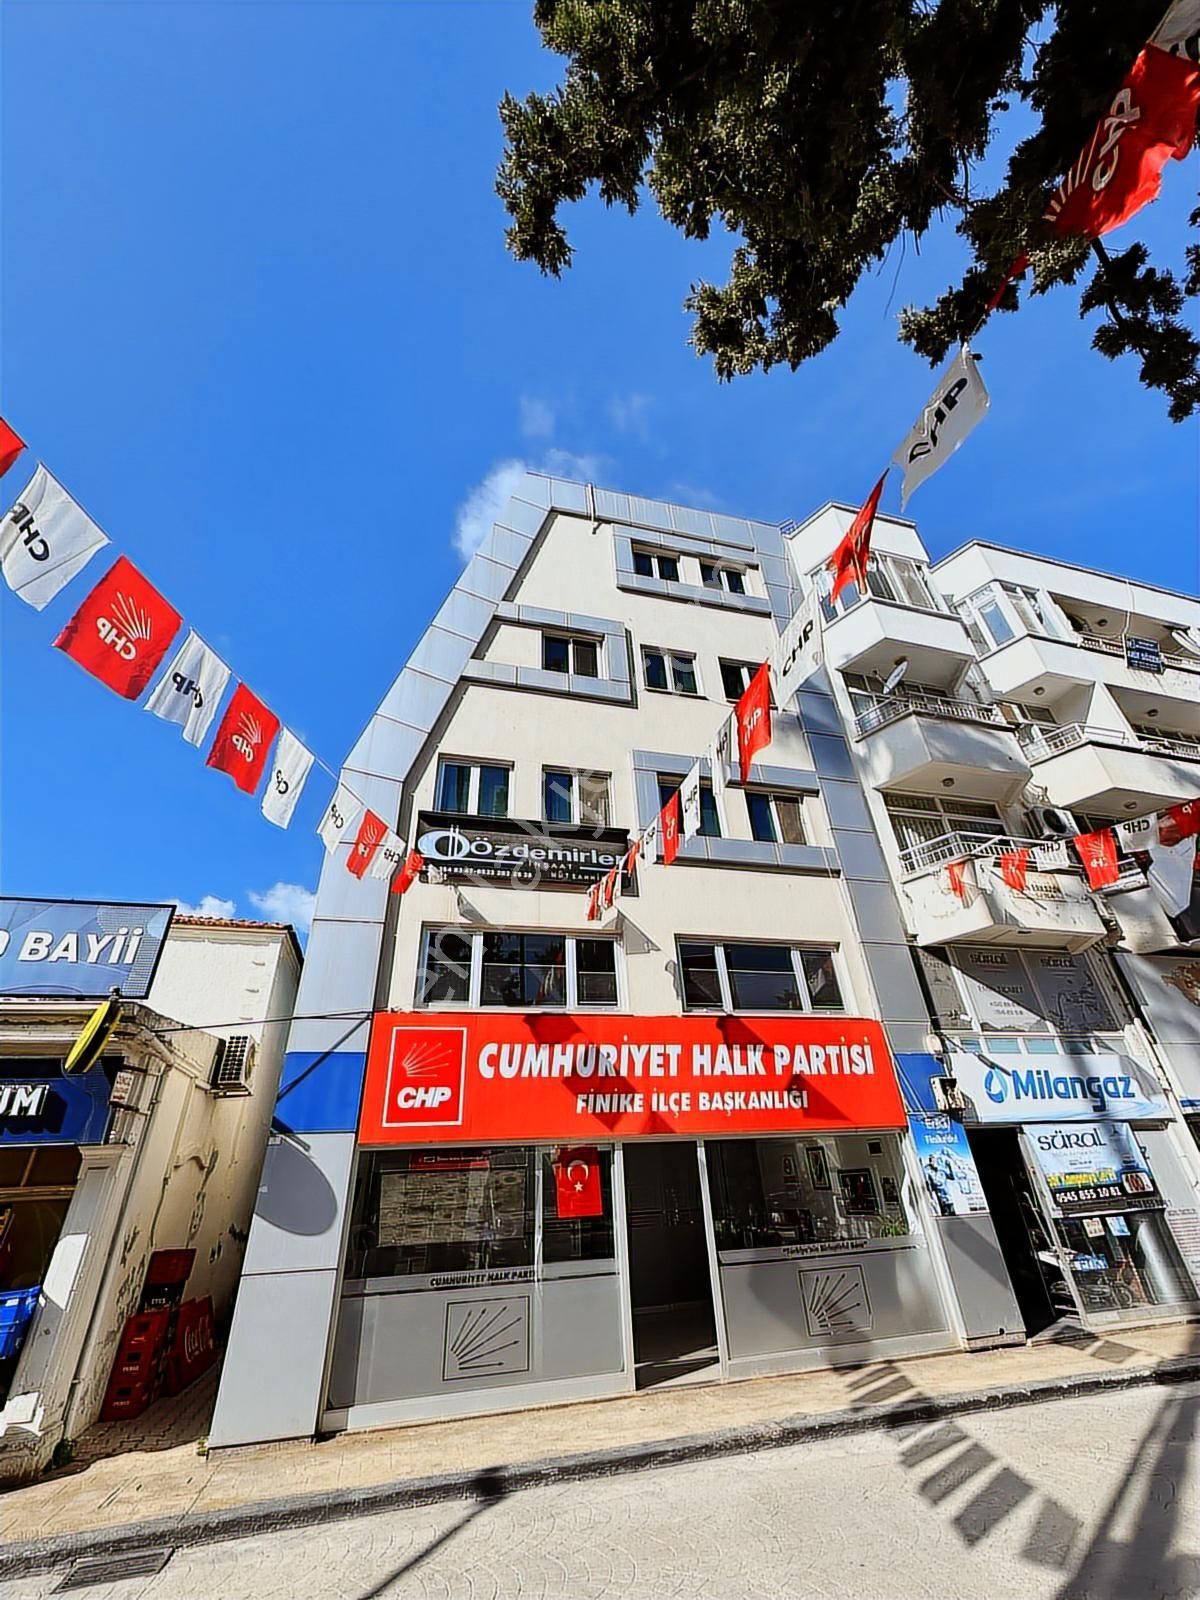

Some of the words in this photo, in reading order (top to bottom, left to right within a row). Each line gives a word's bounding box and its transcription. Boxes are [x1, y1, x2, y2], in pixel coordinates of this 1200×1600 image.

[781, 619, 815, 678] CHP
[477, 1034, 682, 1079] CUMHURİYET
[691, 1043, 767, 1078] HALK
[773, 1035, 875, 1076] PARTİSİ
[396, 1085, 452, 1109] CHP
[575, 1087, 644, 1114] FİNİKE
[651, 1087, 692, 1119] İLÇE
[698, 1084, 809, 1117] BAŞKANLIĞI
[1010, 1068, 1136, 1113] Milangaz
[486, 1271, 511, 1283] HALK
